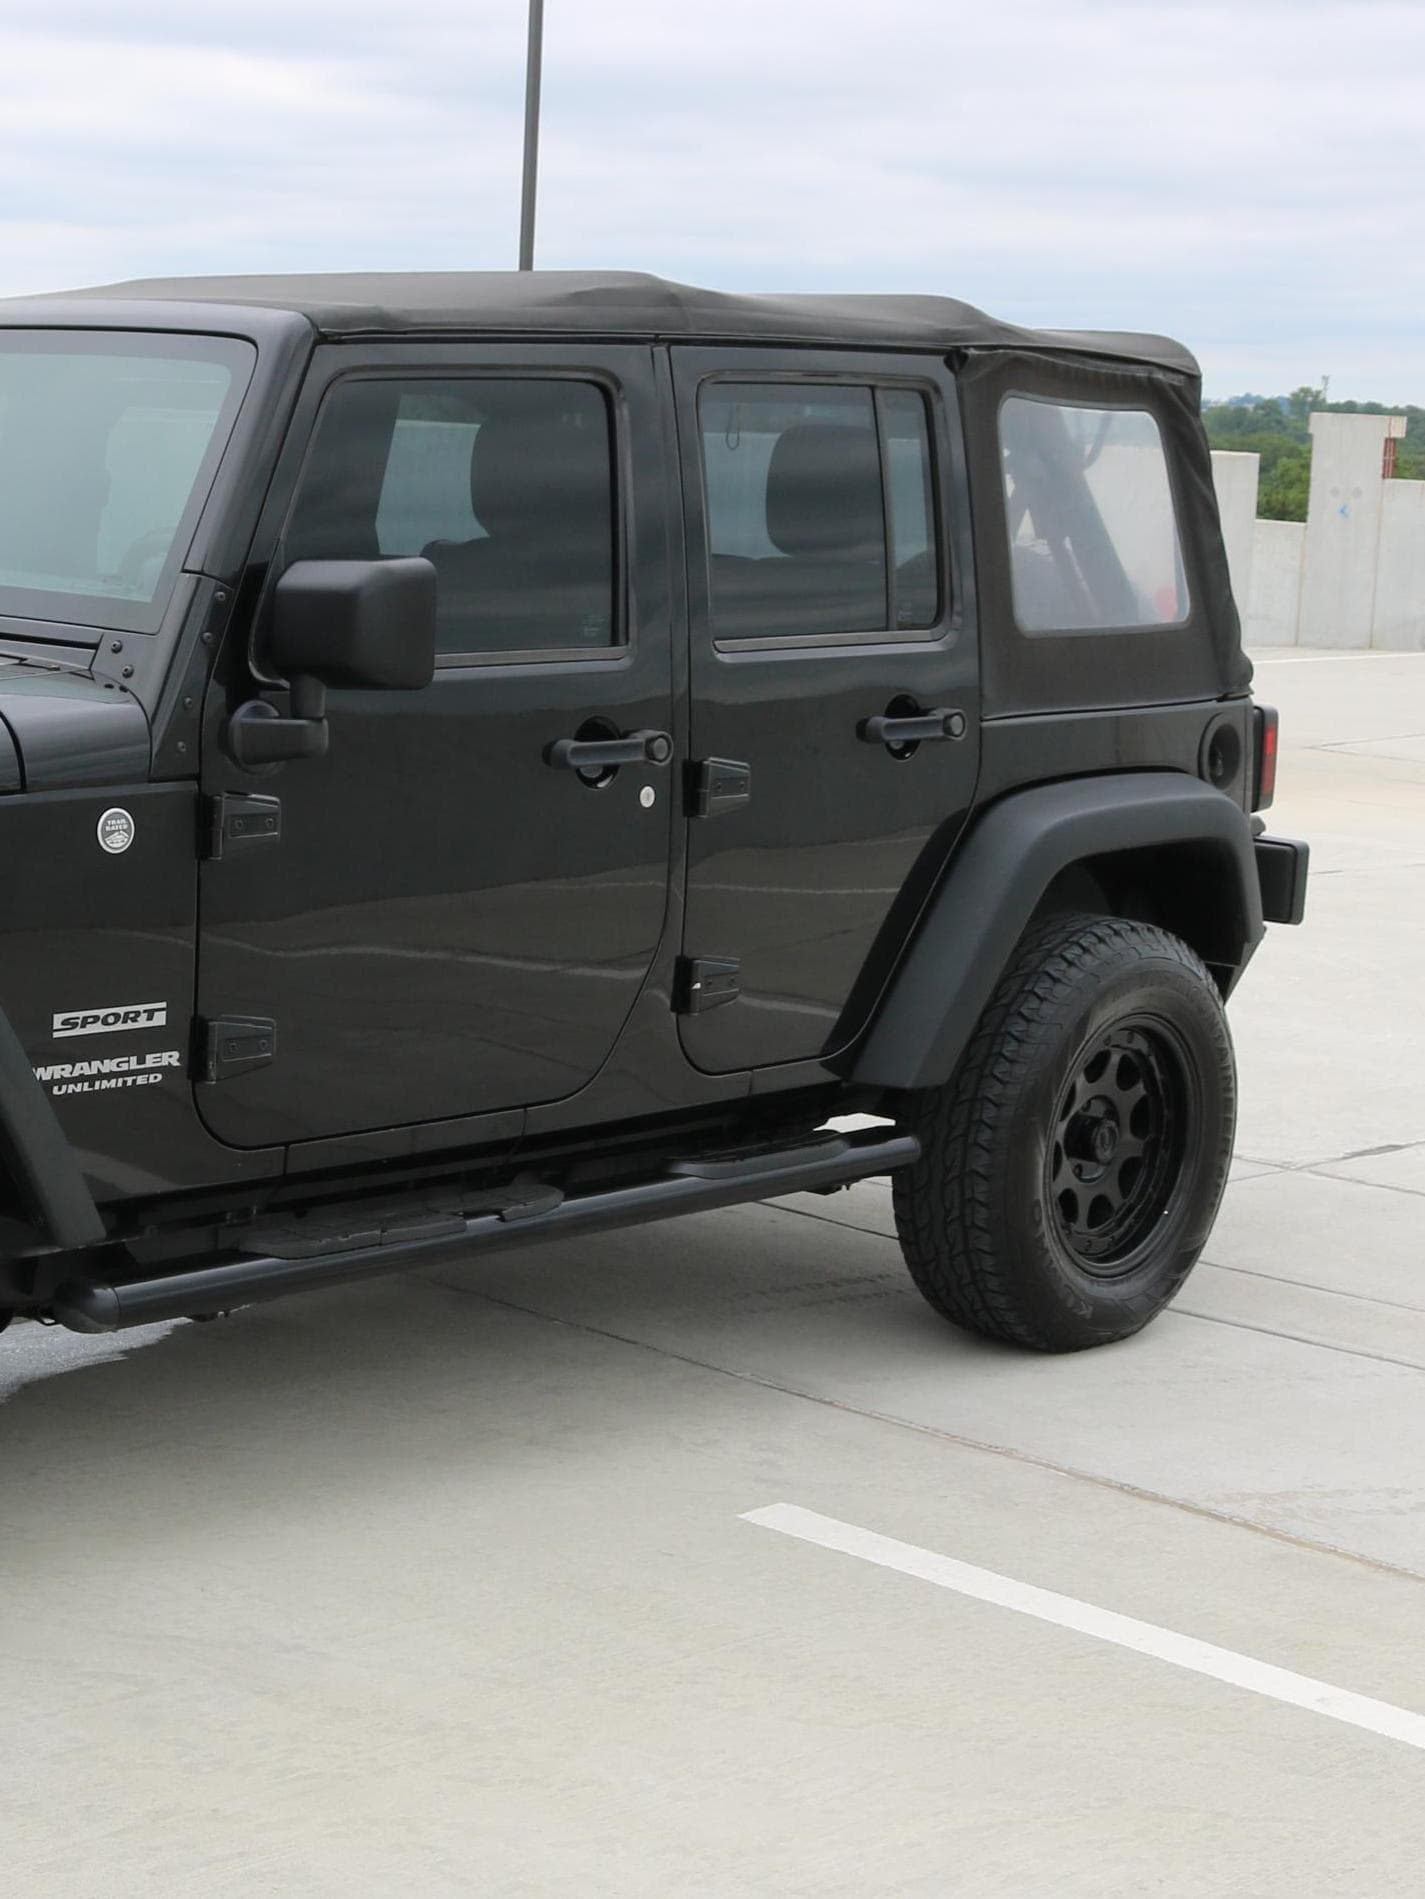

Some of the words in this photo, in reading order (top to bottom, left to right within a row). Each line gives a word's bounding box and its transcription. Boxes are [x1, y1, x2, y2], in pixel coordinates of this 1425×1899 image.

[54, 1006, 167, 1033] SPORT
[32, 1050, 181, 1081] WRANGLER
[52, 1072, 163, 1096] UNLIMITED
